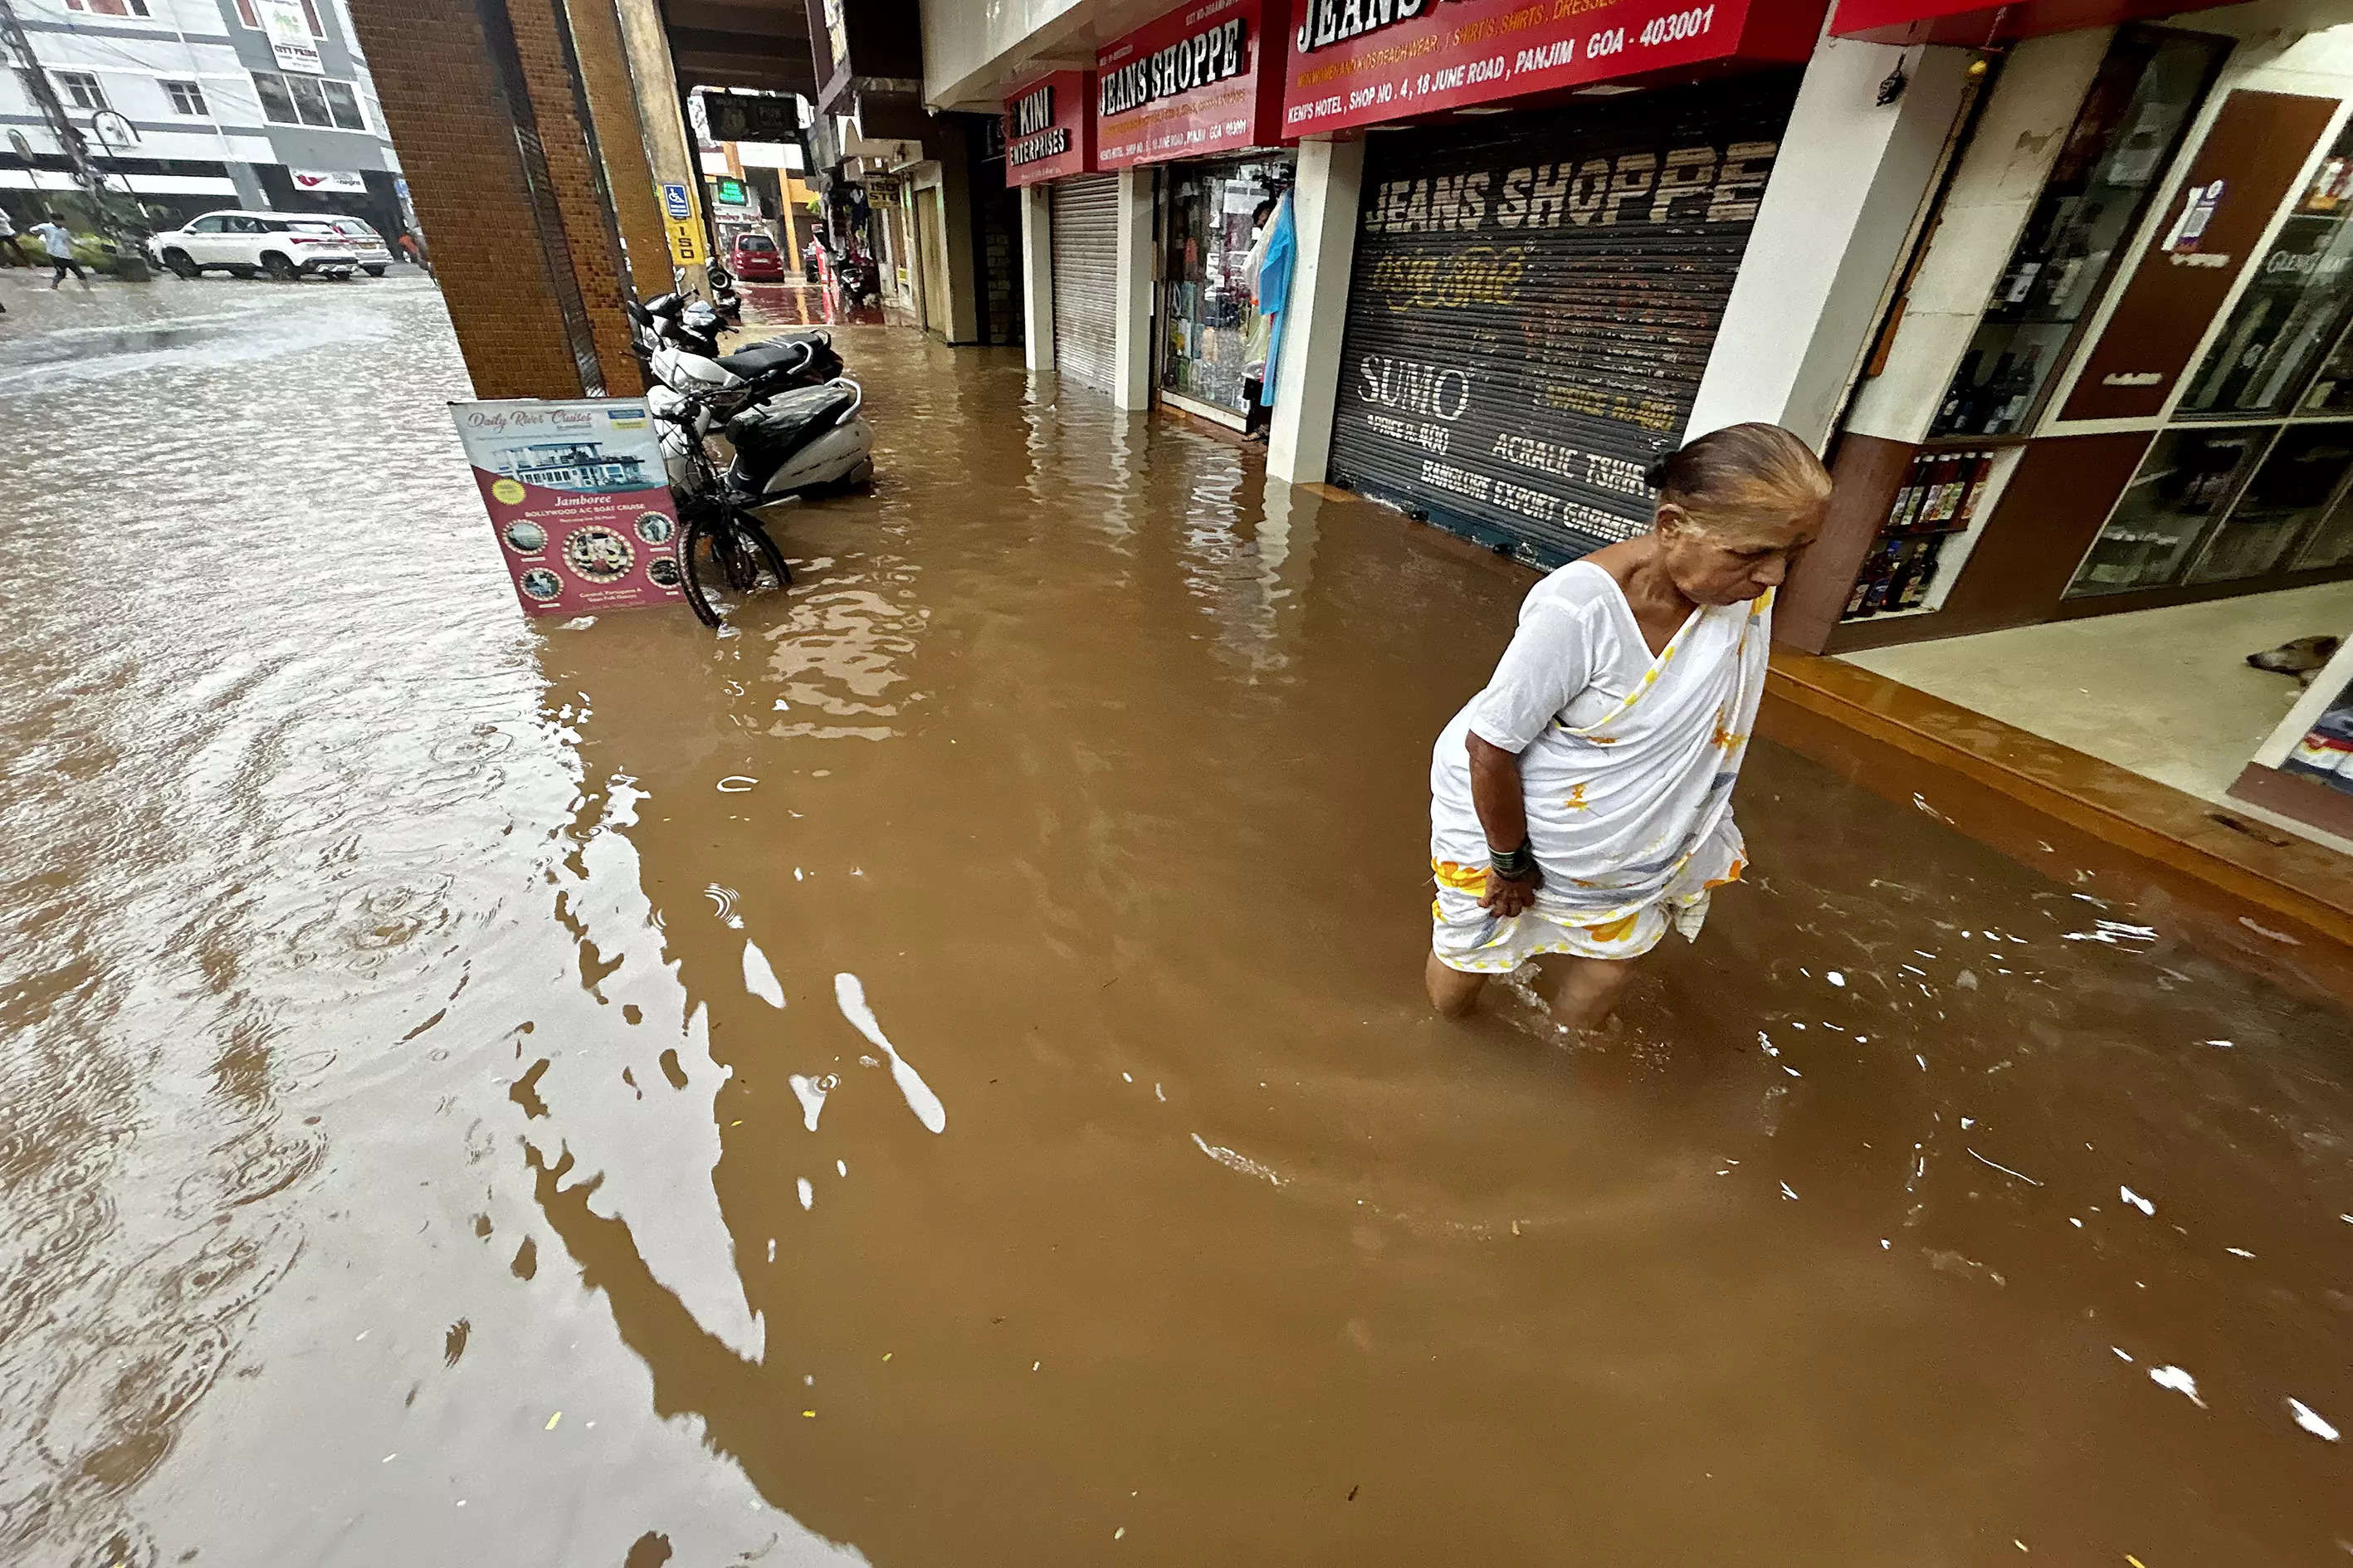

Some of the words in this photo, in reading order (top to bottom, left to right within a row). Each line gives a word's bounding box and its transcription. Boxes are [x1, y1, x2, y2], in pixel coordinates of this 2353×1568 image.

[1296, 0, 1423, 53] JEAN
[1100, 58, 1147, 116] JEANS
[1150, 18, 1239, 98] SHOPPE
[1350, 86, 1375, 110] SHOP
[1417, 73, 1430, 94] 18
[1431, 66, 1466, 92] JUNE
[1514, 38, 1575, 75] PANJIM
[1586, 27, 1625, 59] GOA
[1639, 3, 1716, 47] 403001
[1019, 85, 1049, 136] KINI
[1009, 128, 1065, 166] ENTERPRISES
[1364, 171, 1491, 233] JEANS
[1496, 141, 1778, 230] SHOPPE
[1358, 354, 1469, 421] SUMO
[467, 412, 507, 433] Daily
[510, 411, 544, 427] River
[545, 409, 593, 424] Cruises
[525, 508, 577, 518] BOLLYWOOD
[554, 495, 612, 507] Jamboree
[1492, 481, 1561, 521] EXPORT
